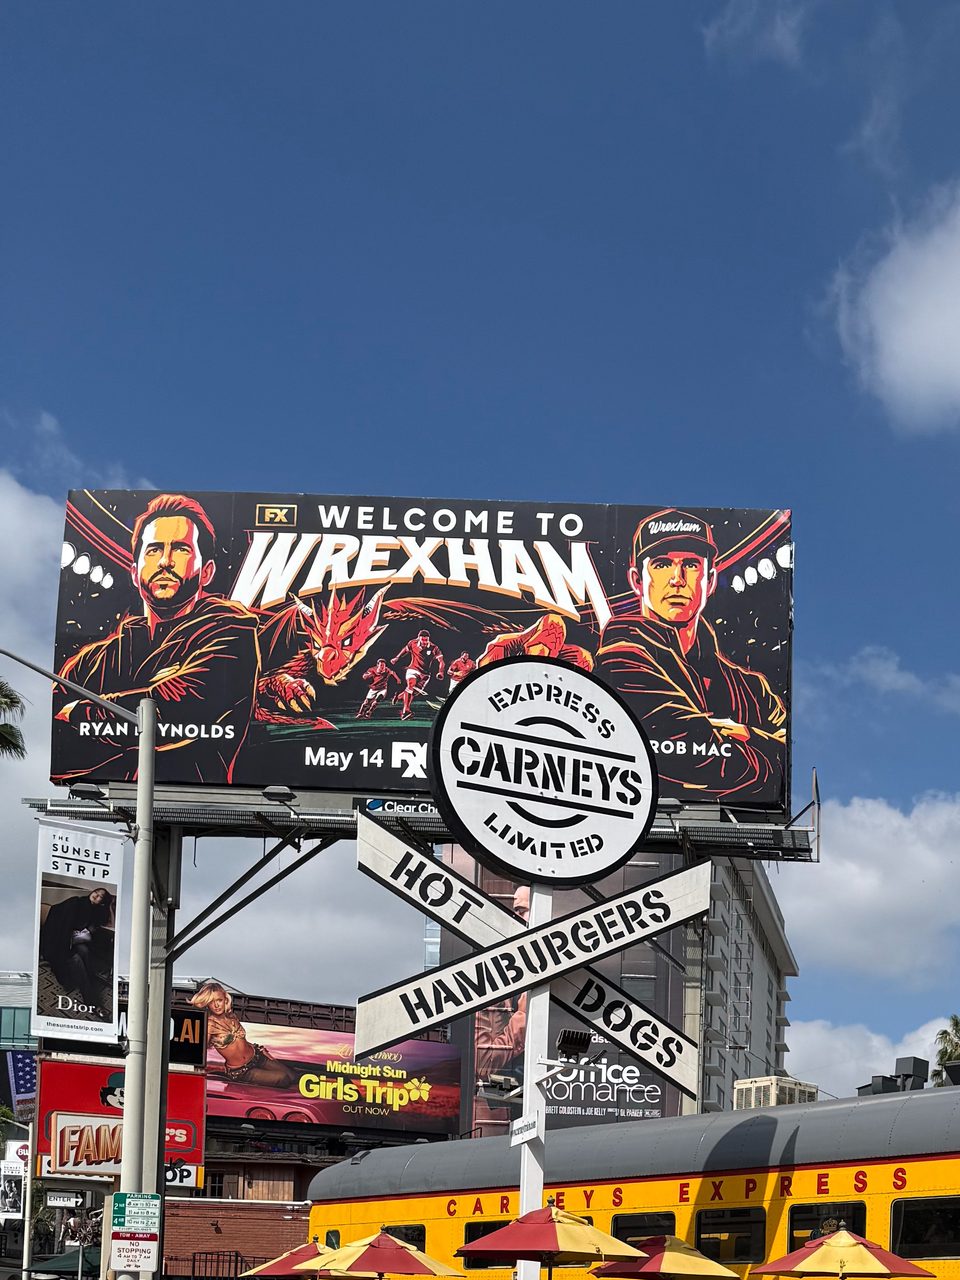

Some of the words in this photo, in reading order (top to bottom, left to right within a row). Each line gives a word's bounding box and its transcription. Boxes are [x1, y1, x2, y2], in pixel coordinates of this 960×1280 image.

[264, 508, 288, 523] FX
[318, 505, 514, 534] WELCOME
[536, 512, 584, 536] TO
[648, 520, 701, 535] Wrexham
[231, 532, 613, 633] WREXHAM
[488, 682, 616, 739] EXPRESS
[79, 722, 128, 736] RYAN
[134, 723, 235, 738] YNOLDS
[650, 740, 687, 754] ROB
[692, 742, 732, 757] MAC
[304, 746, 354, 771] May
[360, 748, 384, 767] 14
[391, 741, 428, 778] FX
[450, 735, 642, 806] CARNEYS
[384, 801, 416, 813] Clear
[52, 834, 69, 842] THE
[483, 812, 604, 860] LIMITED
[52, 843, 111, 861] SUNSET
[51, 860, 110, 879] STRIP
[389, 851, 485, 924] HOT
[399, 889, 672, 1025] HAMBURGERS
[56, 995, 96, 1014] Dior
[572, 977, 684, 1069] DOGS
[326, 1060, 381, 1078] Midnight
[382, 1065, 407, 1079] Sun
[298, 1073, 359, 1102] Girls
[361, 1079, 410, 1111] Trip
[342, 1104, 364, 1113] OUT
[365, 1106, 390, 1116] NOW
[446, 1186, 623, 1216] CAREYS
[678, 1167, 907, 1203] EXPRESS
[113, 1217, 118, 1225] 4
[117, 1247, 151, 1255] STOPPING
